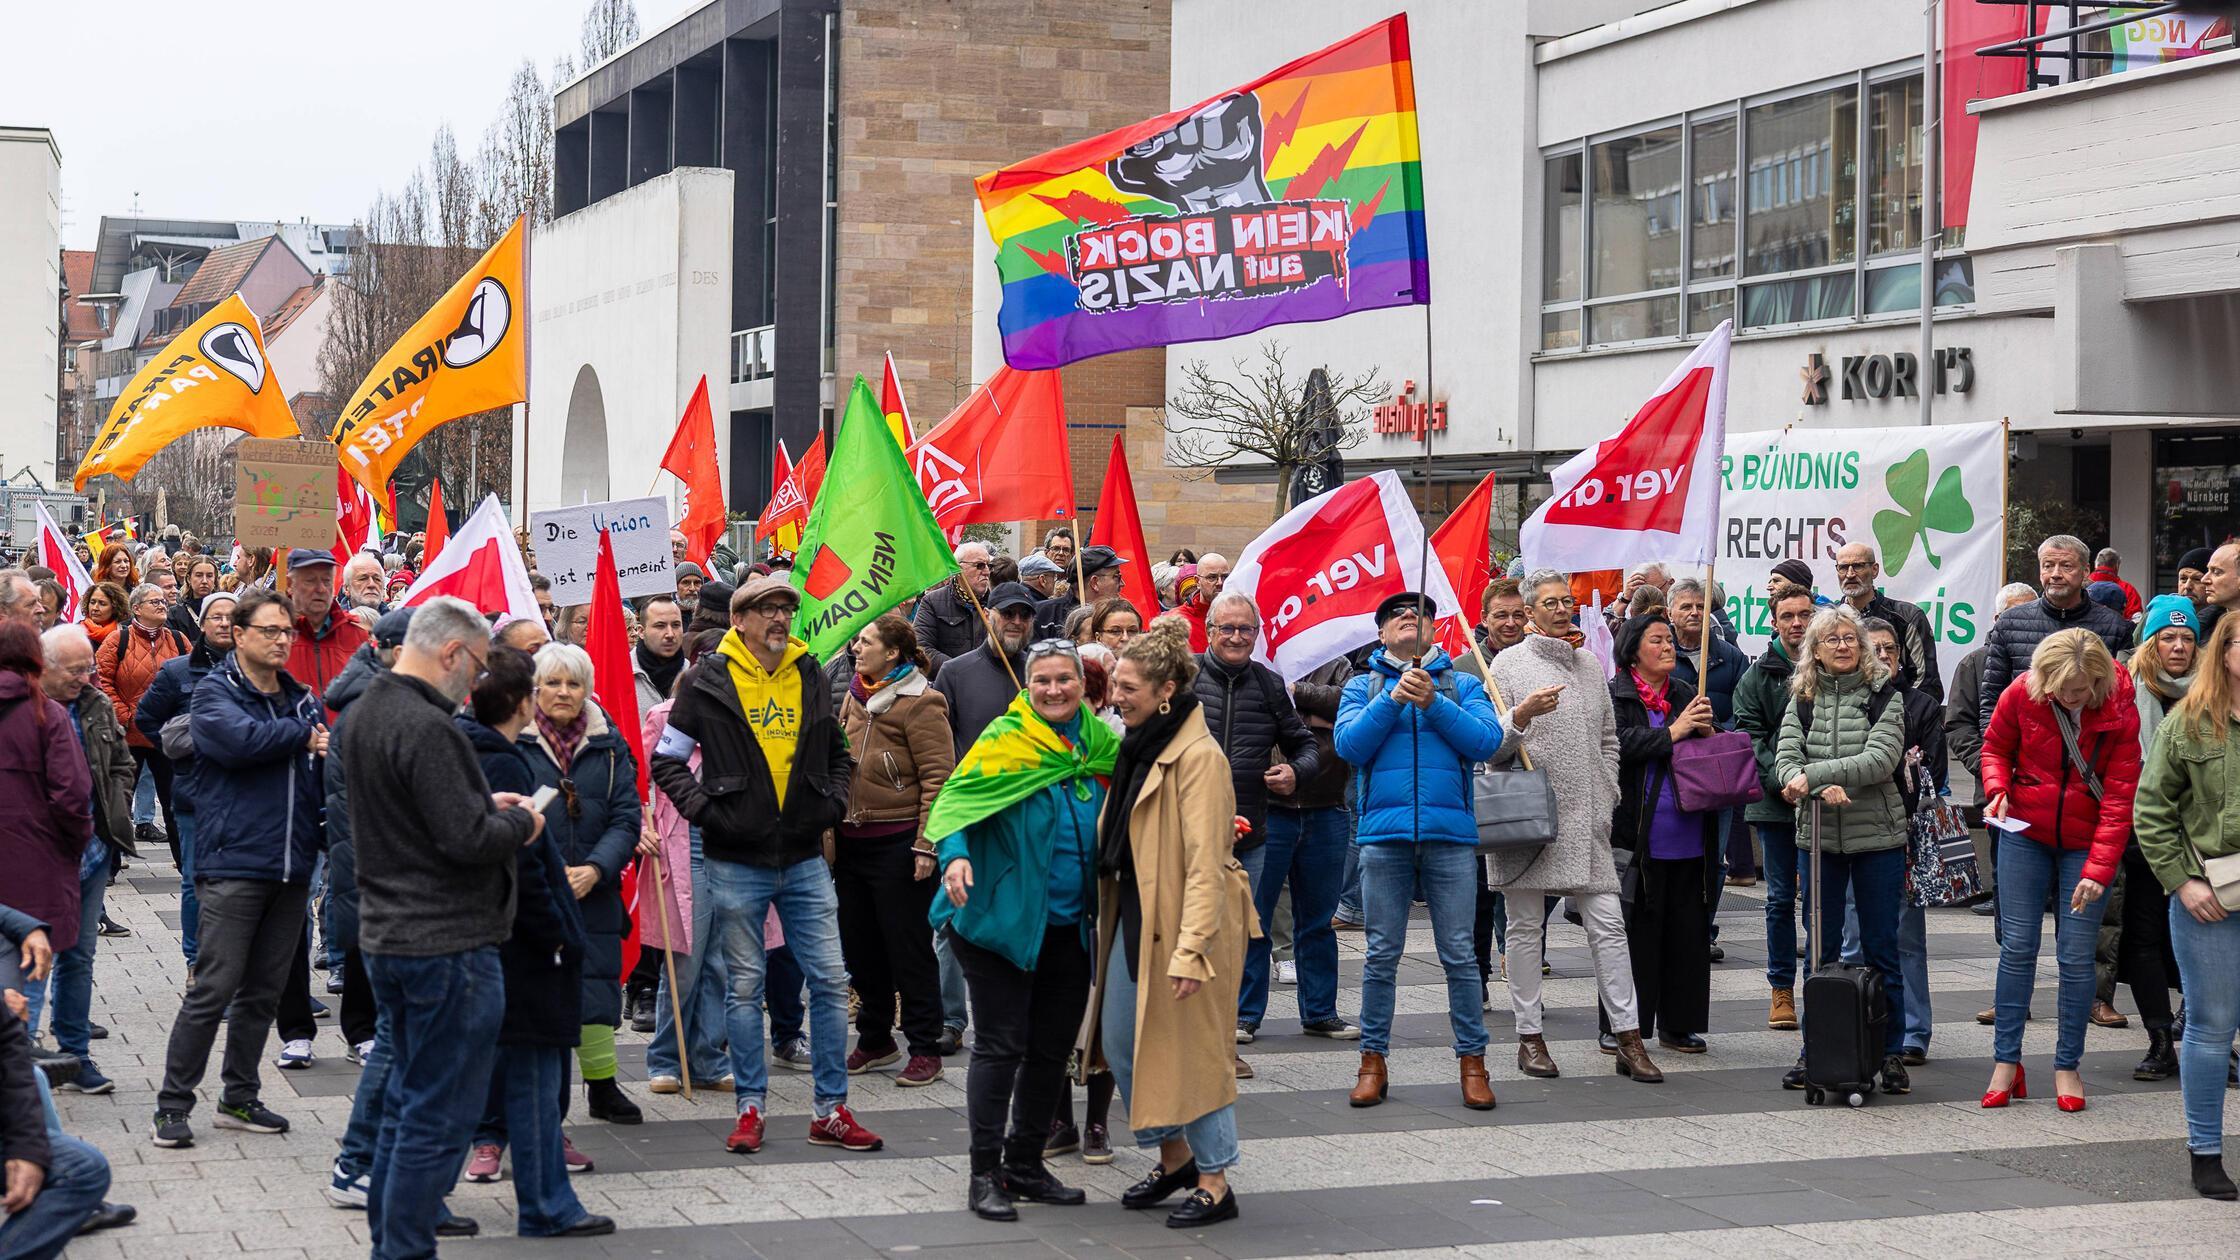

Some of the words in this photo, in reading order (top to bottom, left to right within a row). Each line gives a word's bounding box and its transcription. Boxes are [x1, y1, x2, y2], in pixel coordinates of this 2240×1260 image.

[692, 271, 719, 285] DES
[1742, 445, 1860, 491] BÜNDNIS
[2187, 490, 2229, 504] Nürnberg
[544, 522, 578, 542] Die
[592, 511, 650, 534] Union
[1727, 517, 1847, 560] RECHTS
[554, 568, 577, 586] ist
